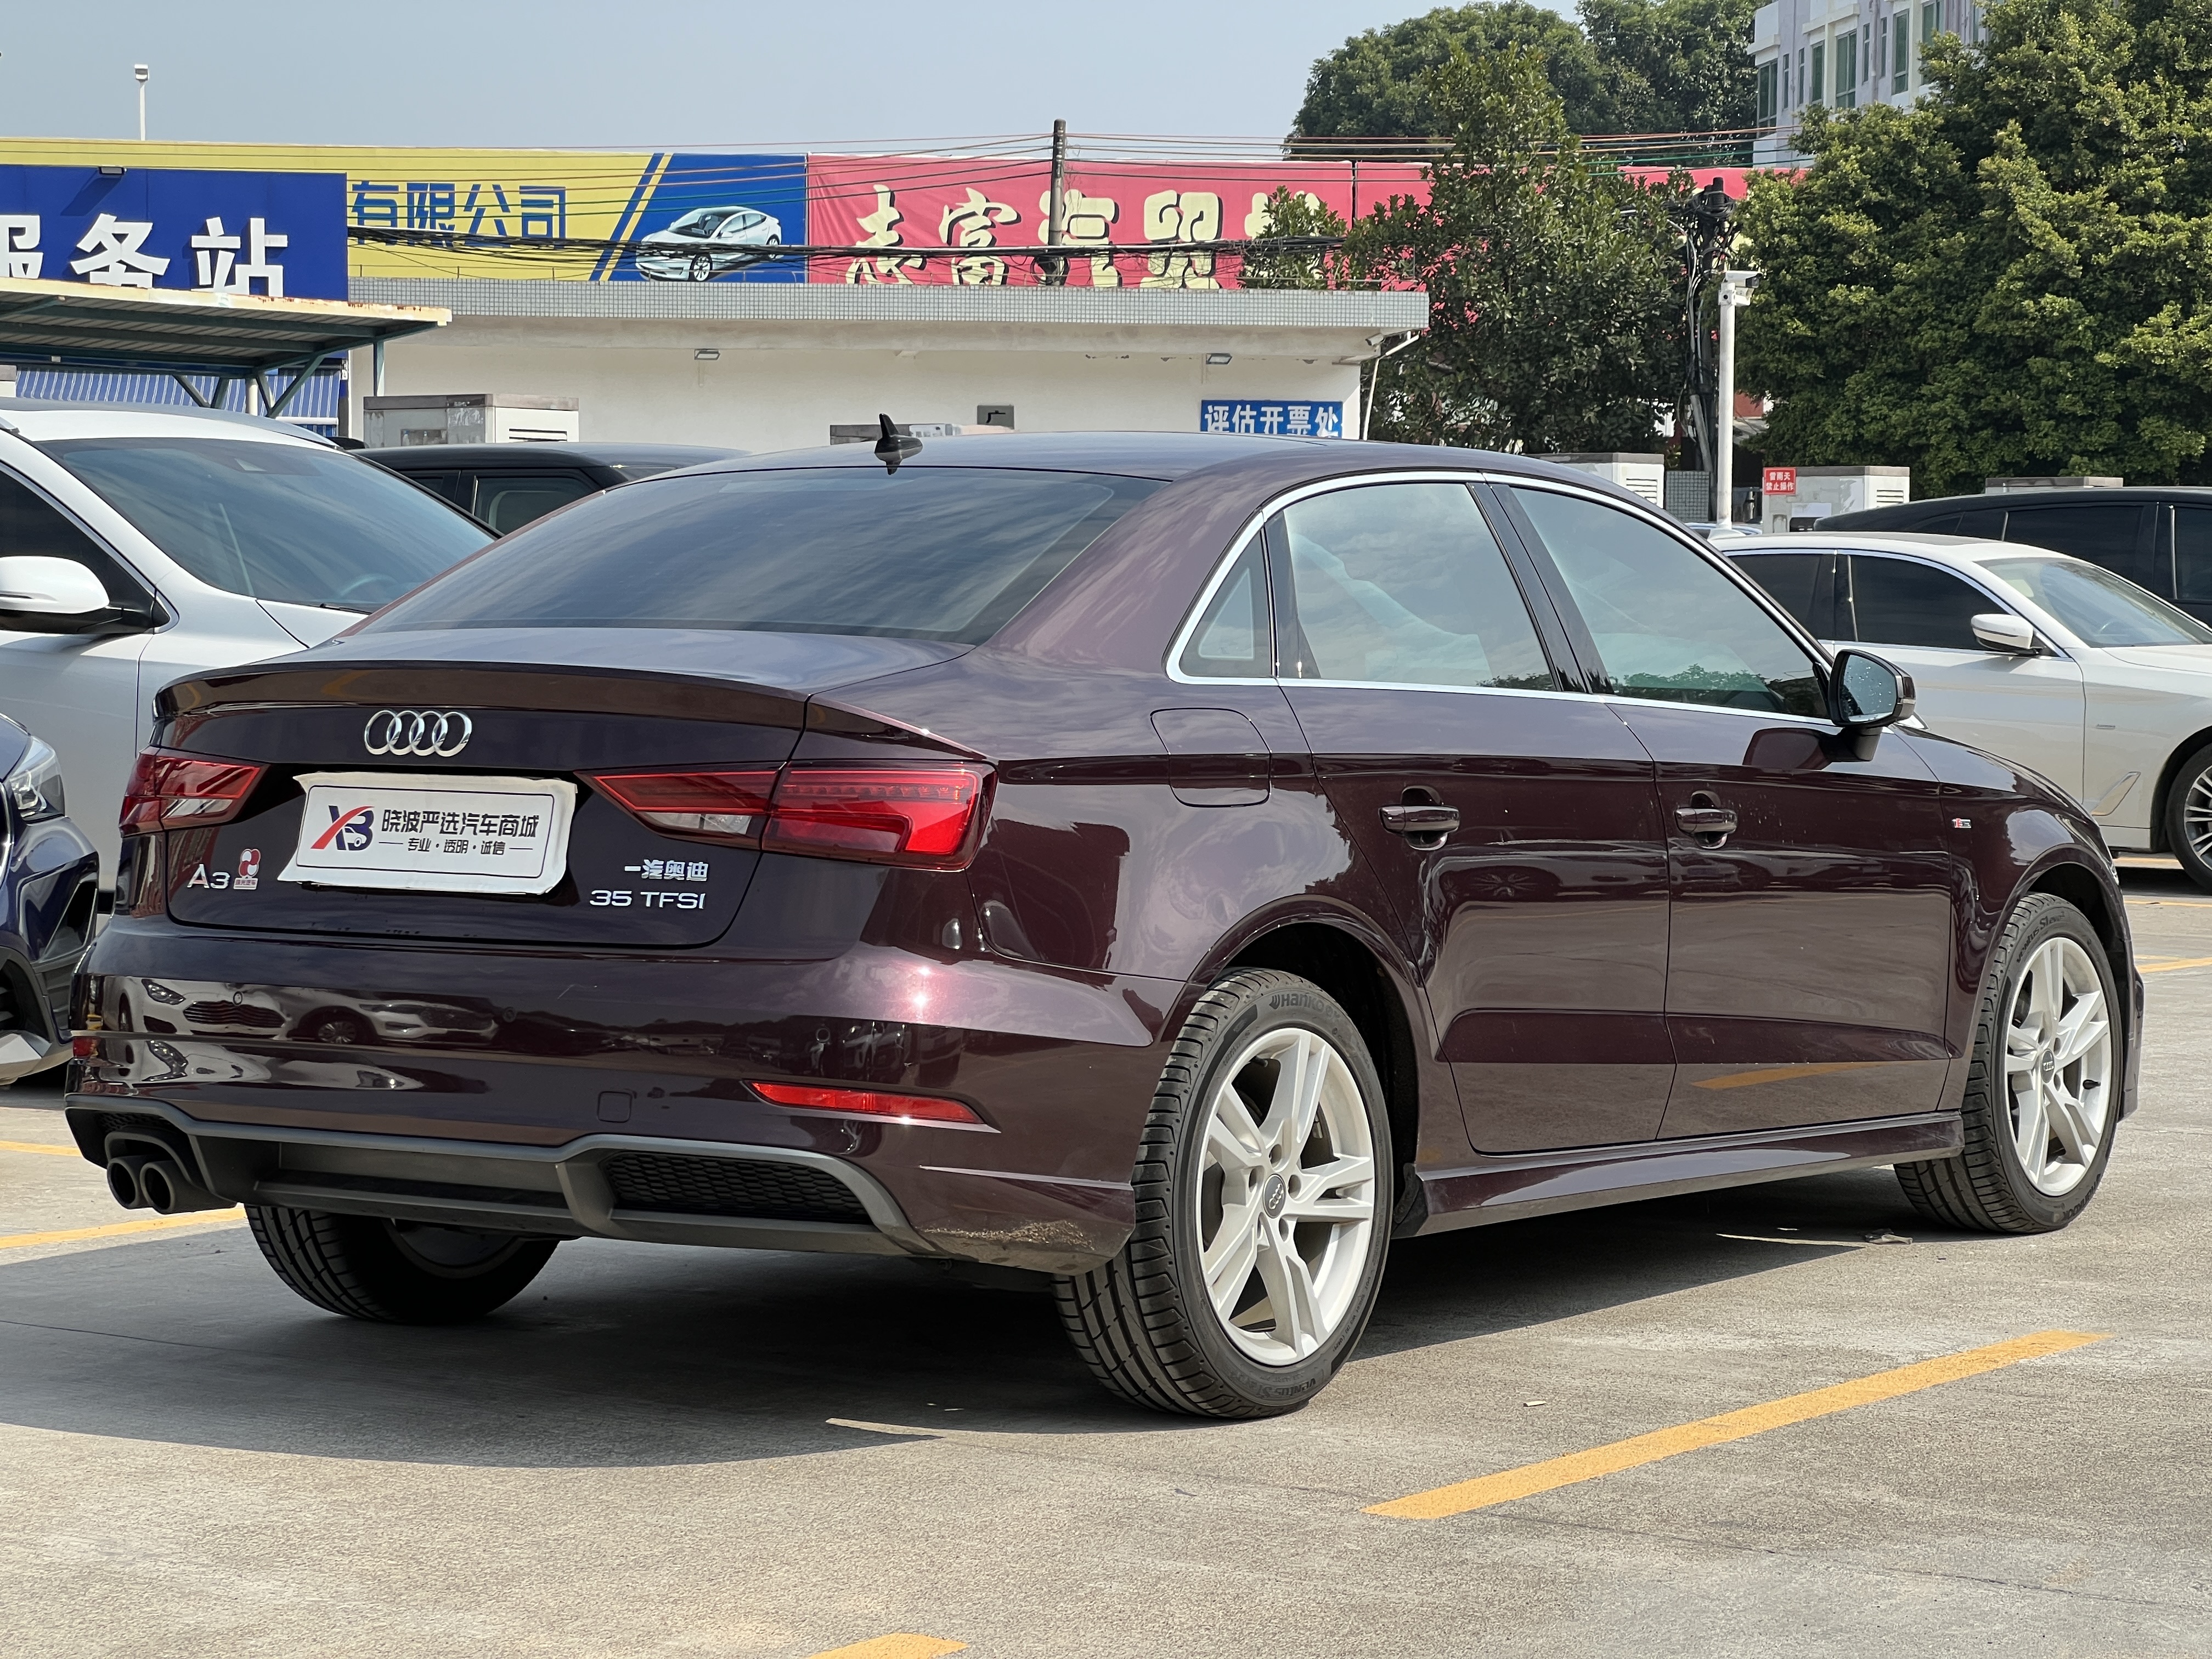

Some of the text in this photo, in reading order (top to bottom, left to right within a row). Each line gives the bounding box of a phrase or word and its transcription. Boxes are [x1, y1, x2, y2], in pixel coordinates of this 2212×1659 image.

[352, 180, 566, 249] 有限公司
[1205, 404, 1339, 437] 评估开票处
[381, 809, 539, 838] 晓波严选汽车商城
[187, 864, 230, 889] A3
[624, 859, 708, 881] 一汽奥迪
[589, 890, 706, 909] 35 TFSI
